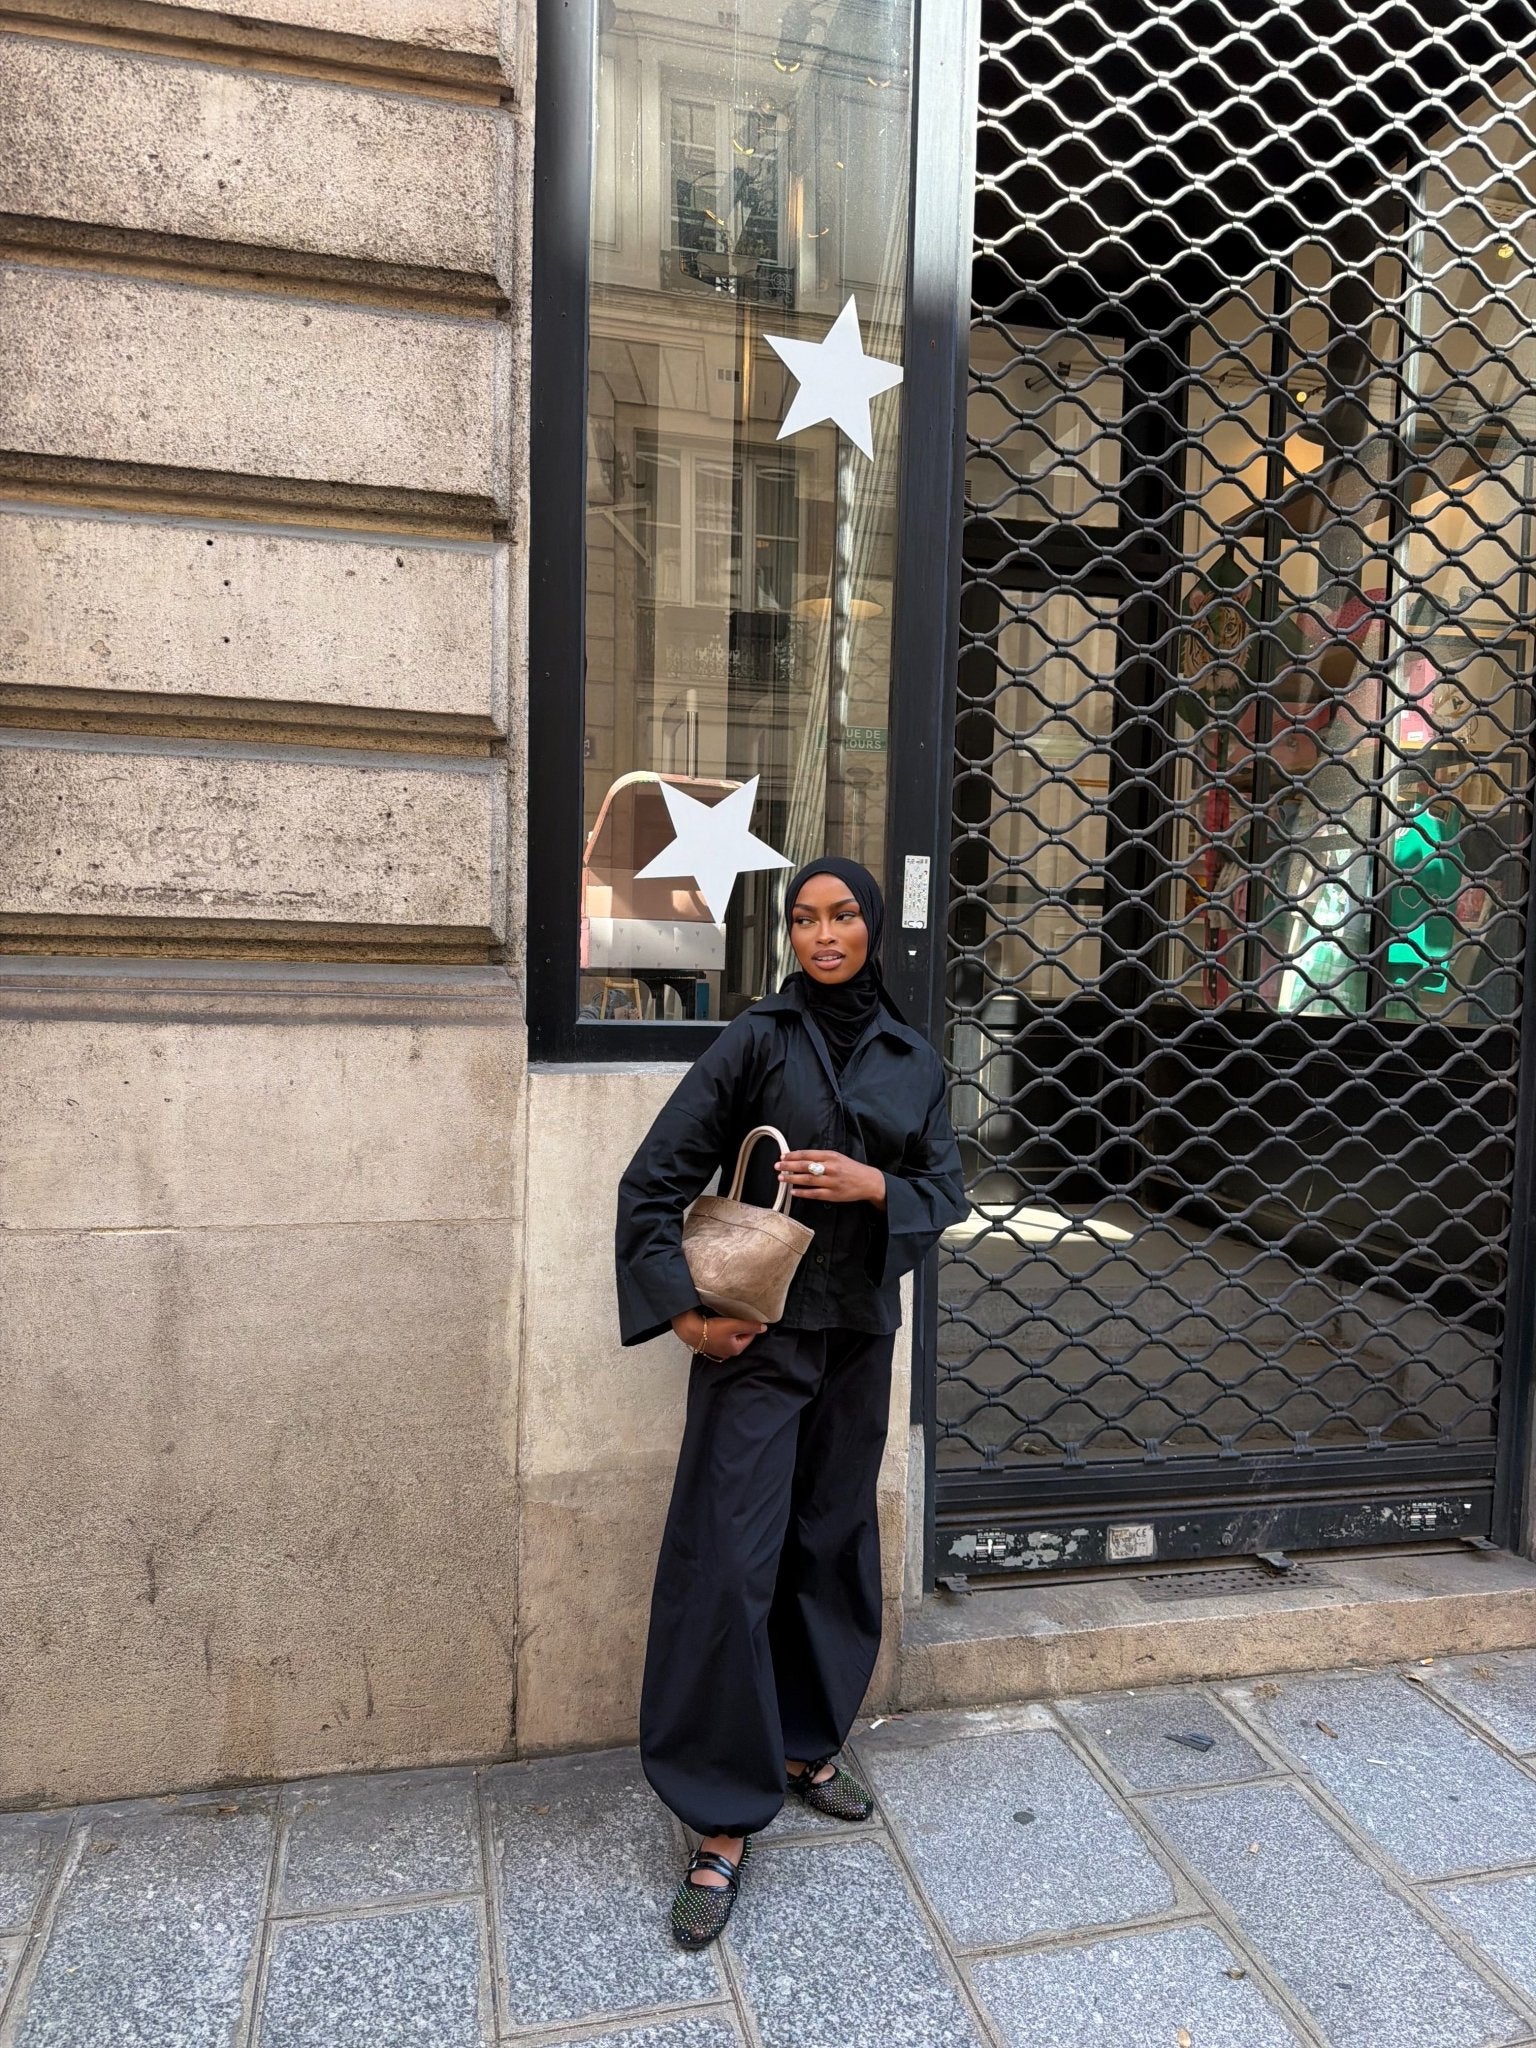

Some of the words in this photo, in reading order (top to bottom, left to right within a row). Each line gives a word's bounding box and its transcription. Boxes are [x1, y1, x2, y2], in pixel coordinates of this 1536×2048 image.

[846, 728, 862, 738] UE
[865, 729, 881, 739] DE
[847, 739, 882, 750] OURS
[1135, 1528, 1147, 1537] CE
